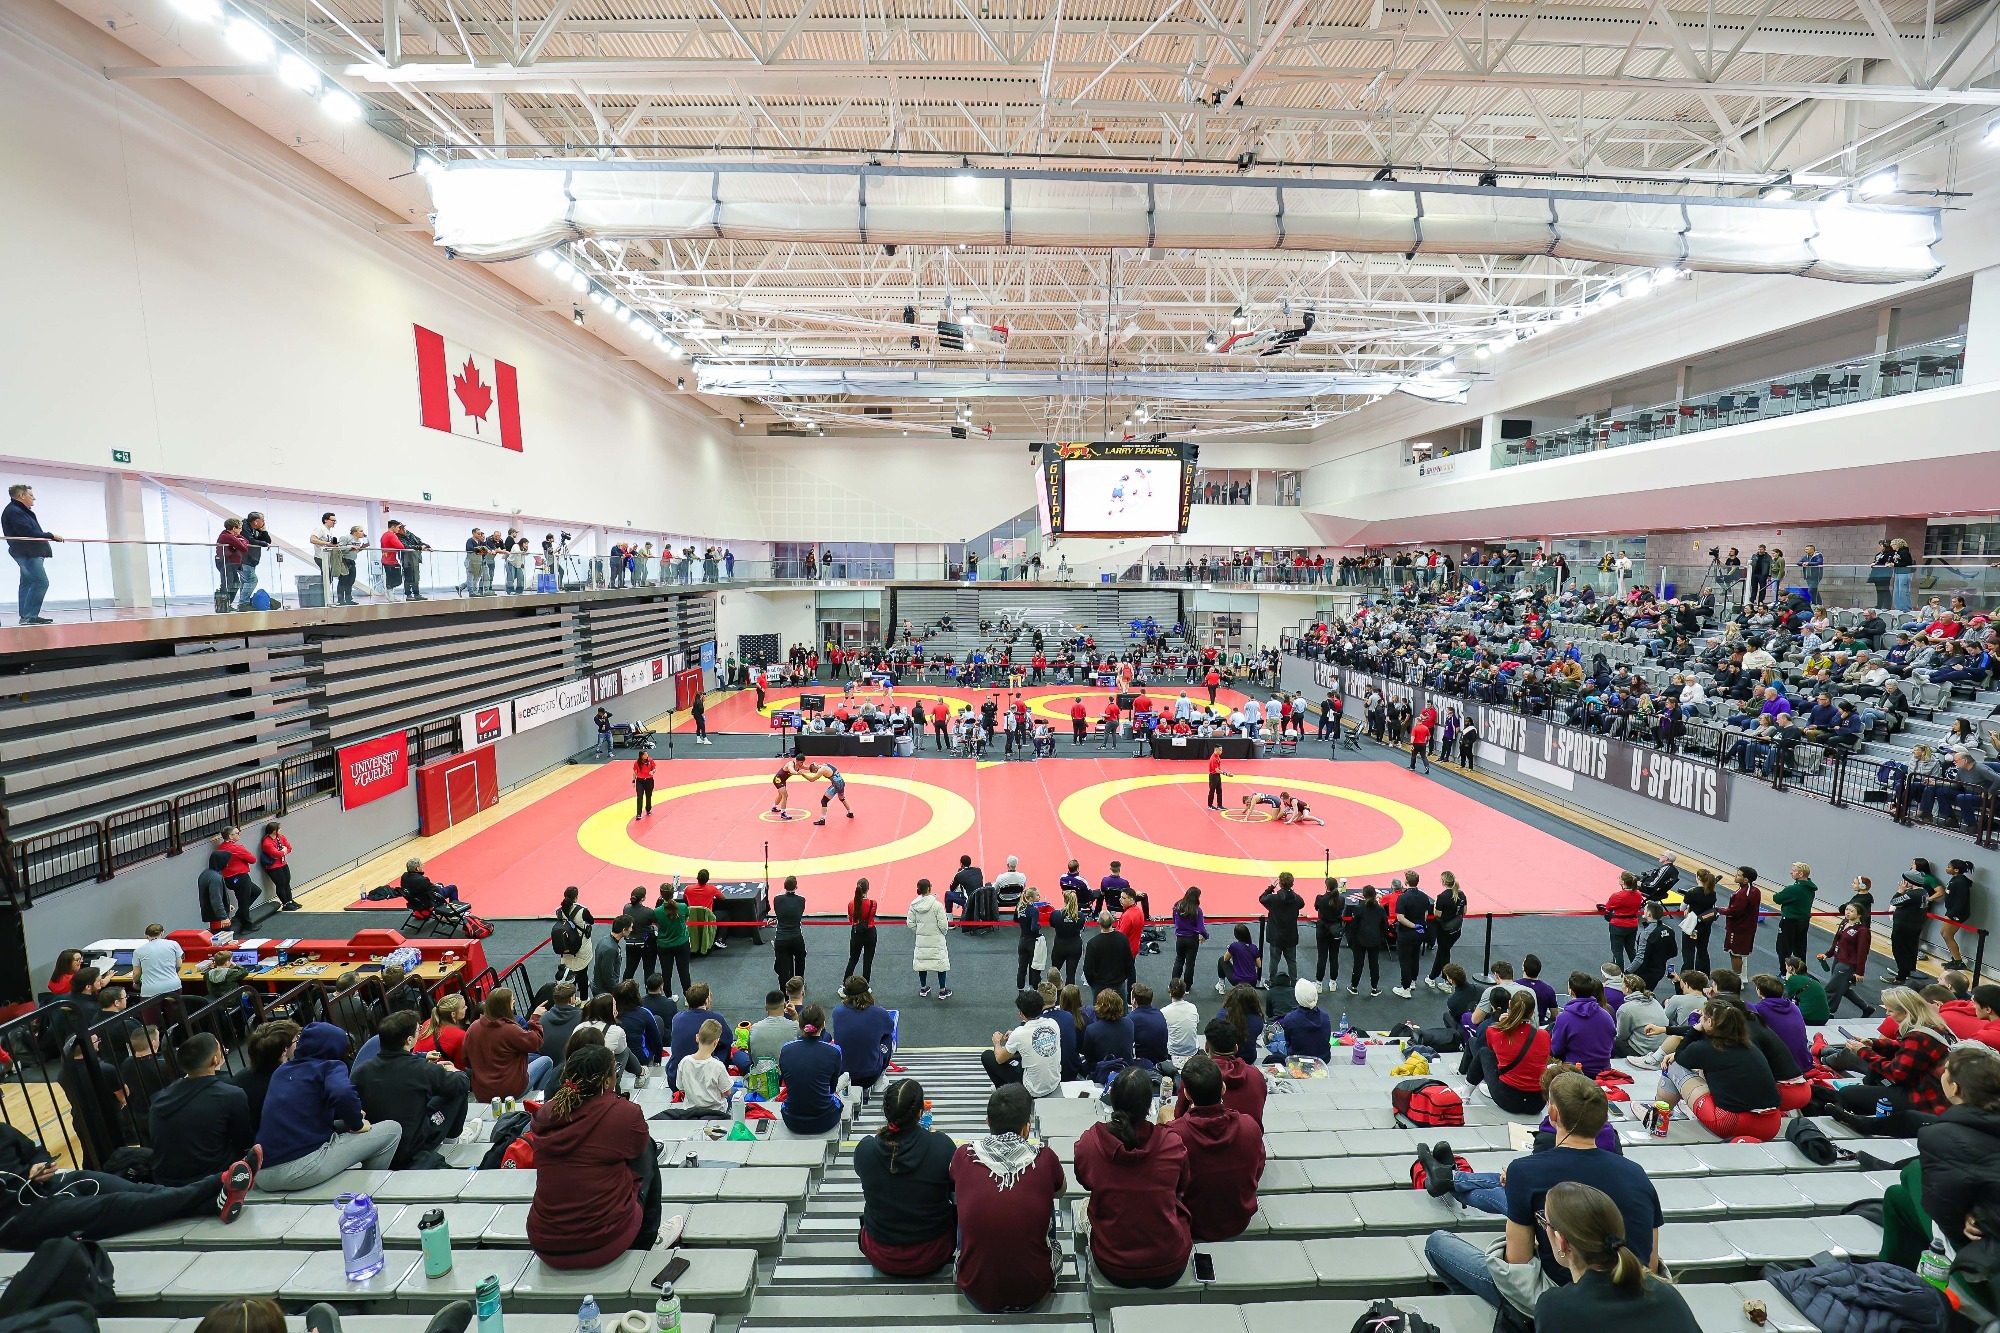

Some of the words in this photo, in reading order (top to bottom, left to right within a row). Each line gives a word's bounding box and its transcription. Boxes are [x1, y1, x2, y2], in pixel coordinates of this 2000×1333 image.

[1104, 447, 1133, 455] LARRY
[1135, 447, 1175, 455] PEARSON
[1049, 464, 1061, 527] GUELPH
[1181, 464, 1193, 527] GUELPH
[558, 684, 589, 711] Canada
[478, 729, 498, 741] TEAM
[1487, 708, 1527, 753] SPORTS
[349, 749, 400, 779] UNIVERSITY
[1557, 728, 1608, 780] SPORTS
[354, 774, 361, 787] of
[360, 763, 394, 787] GUELPH
[1647, 752, 1717, 816] SPORTS
